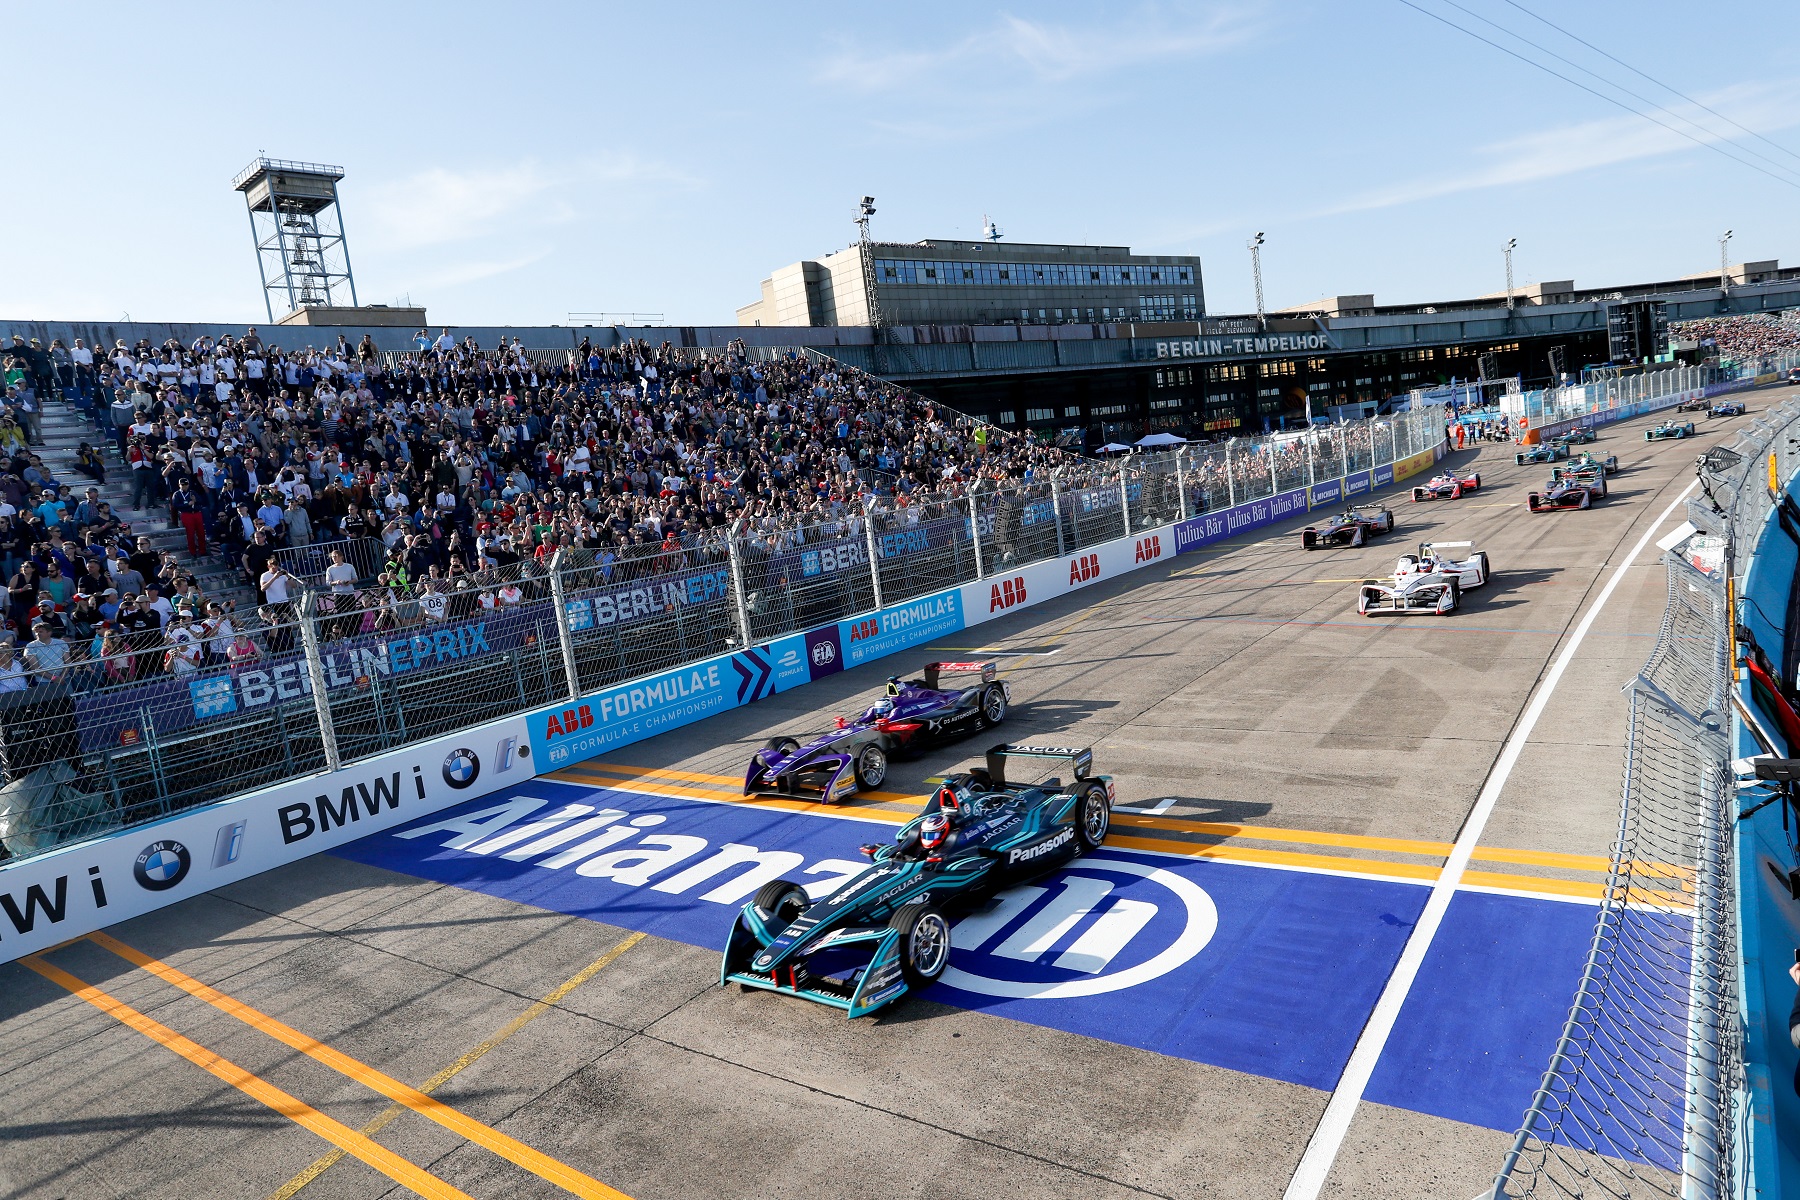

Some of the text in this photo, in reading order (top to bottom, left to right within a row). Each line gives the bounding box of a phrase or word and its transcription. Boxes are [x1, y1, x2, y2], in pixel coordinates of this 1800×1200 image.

[1156, 334, 1328, 359] BERLIN-TEMPELHOF
[1317, 488, 1340, 501] MICHELIN
[1350, 479, 1369, 490] MICHELIN
[1227, 505, 1267, 533] Julius Bär
[1270, 493, 1306, 519] Julius Bär
[1135, 535, 1161, 564] ABB
[1176, 518, 1223, 550] Julius Bär
[1069, 553, 1100, 586] ABB
[428, 598, 443, 609] 08
[989, 576, 1027, 613] ABB
[850, 595, 955, 643] ABB FORMULA-E
[865, 635, 906, 655] FORMULA-E
[909, 618, 957, 641] CHAMPIONSHIP
[546, 664, 721, 741] ABB FORMULA-E
[572, 723, 641, 754] FORMULA-E
[646, 695, 724, 729] CHAMPIONSHIP
[1011, 745, 1084, 754] JAGUAR
[277, 765, 426, 845] BMW i
[982, 817, 1023, 844] JAGUAR
[1008, 825, 1075, 865] Panasonic
[0, 865, 108, 941] W i
[875, 873, 924, 907] JAGUAR
